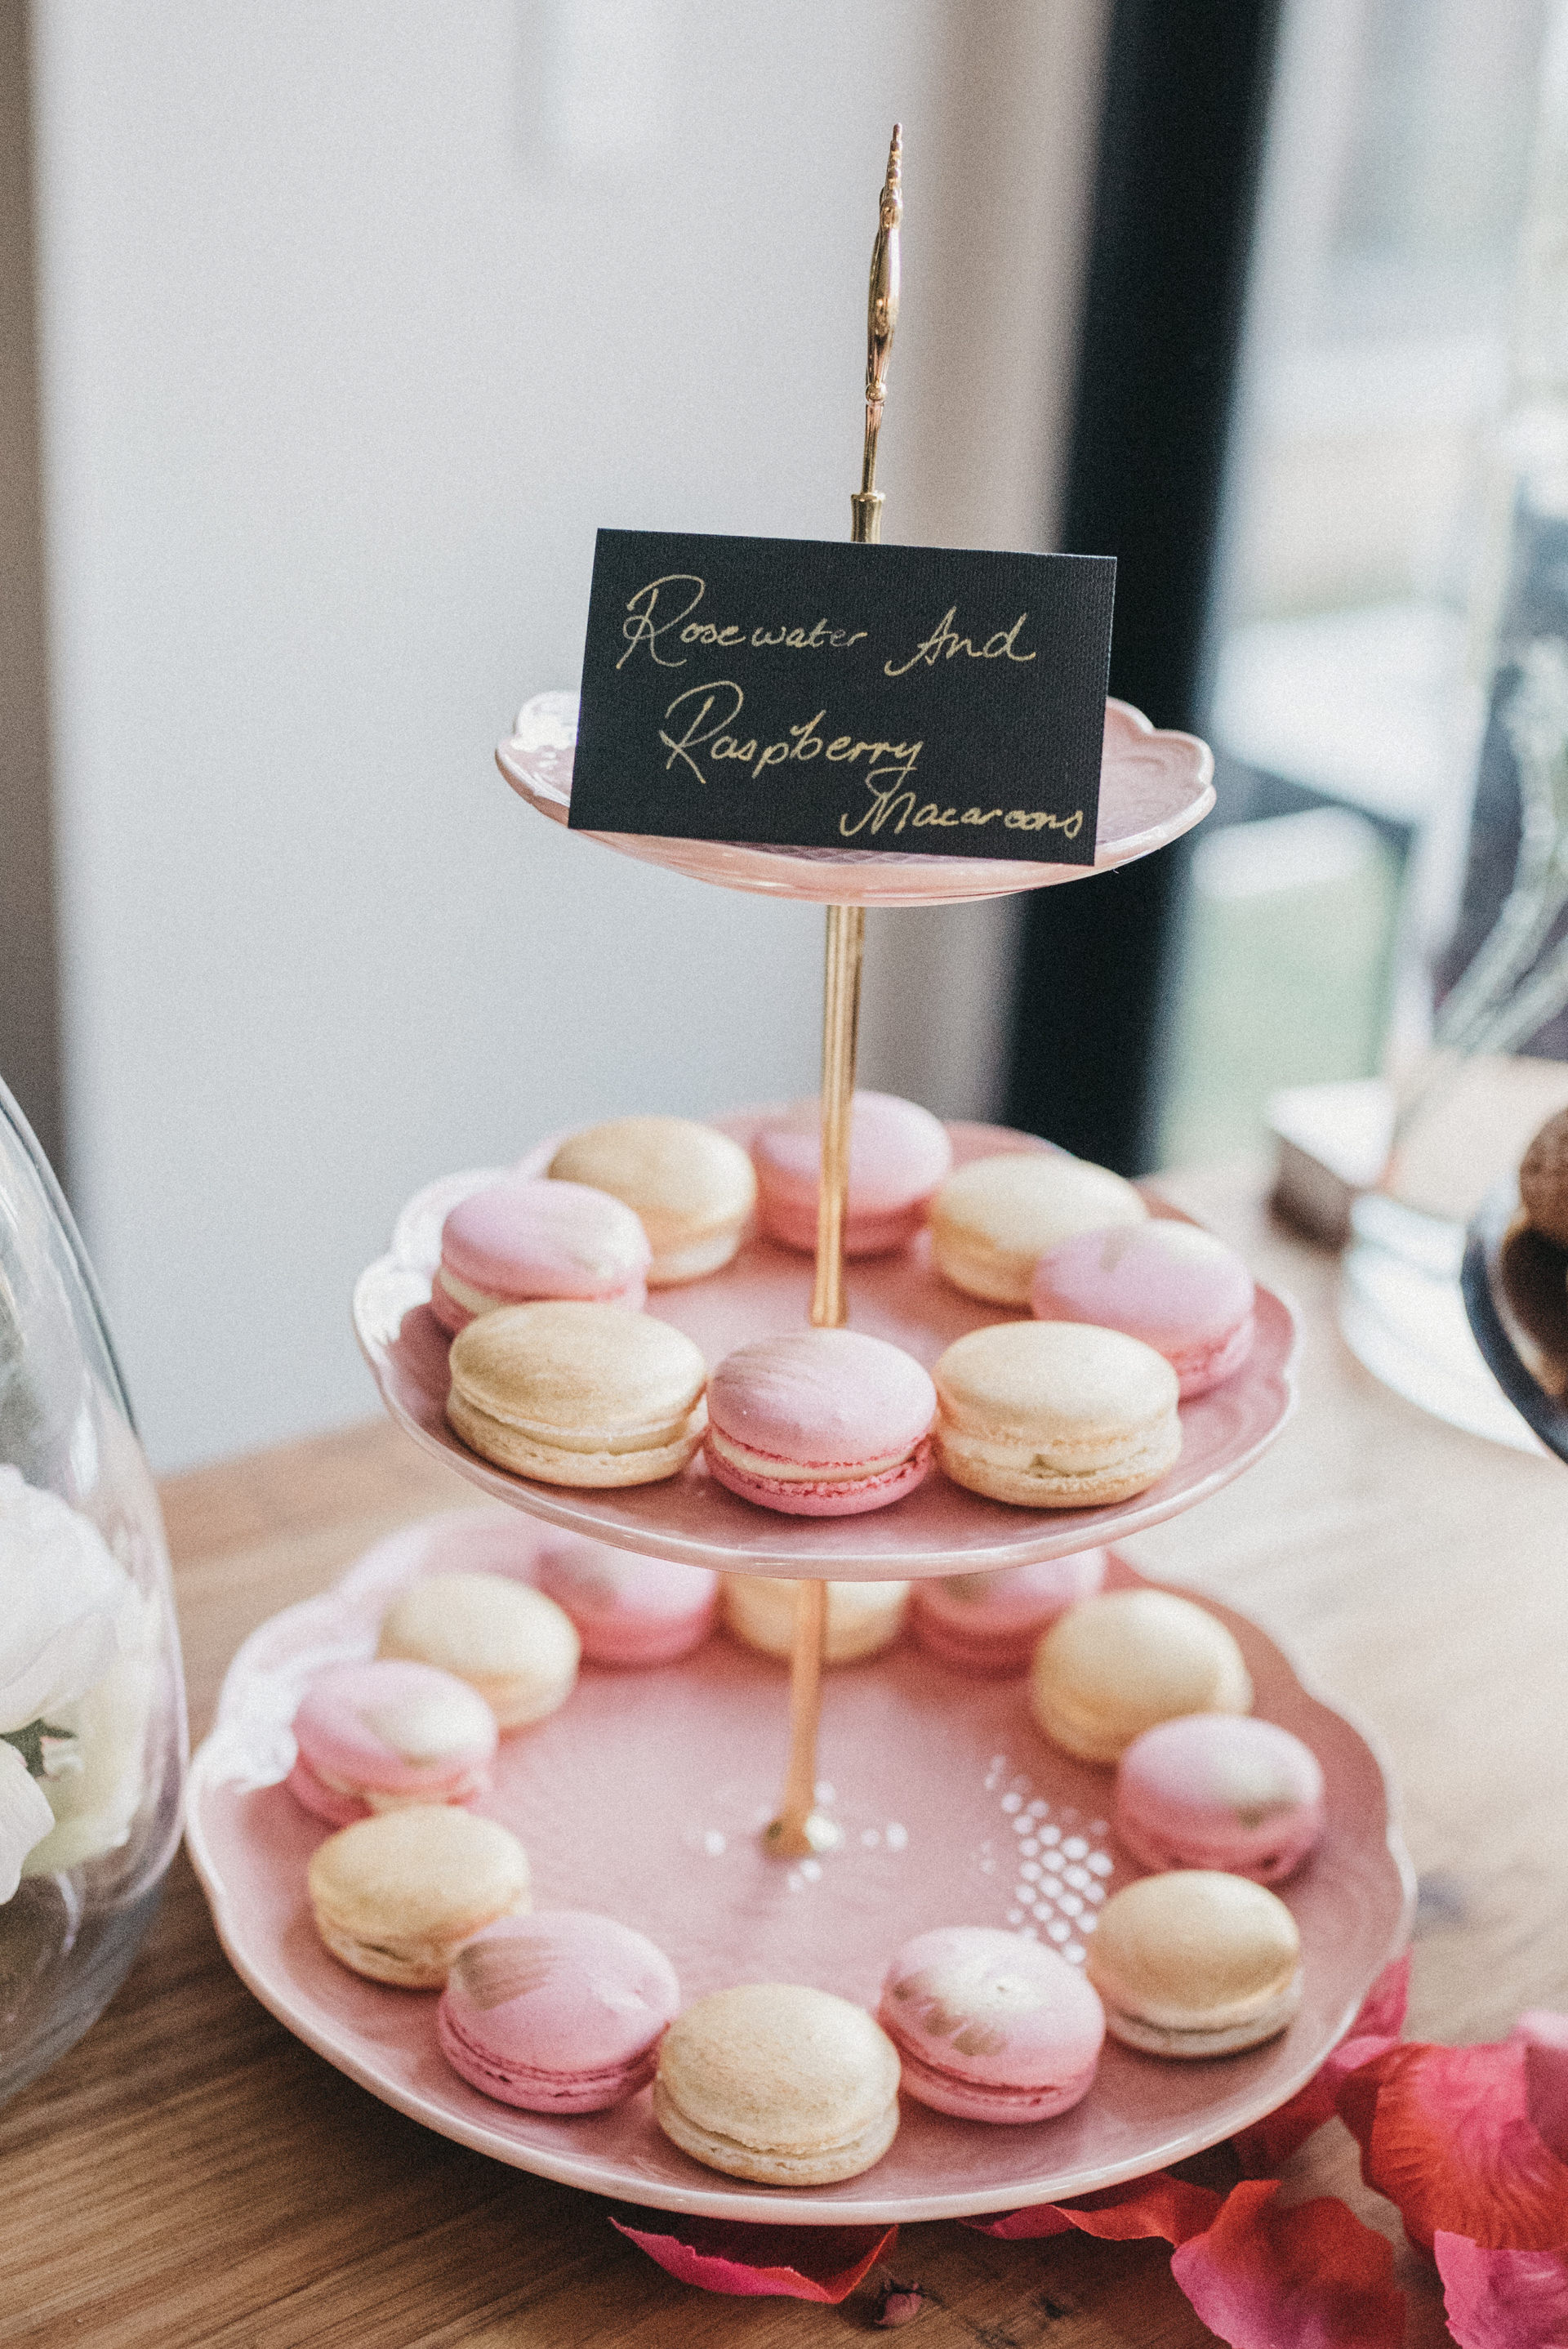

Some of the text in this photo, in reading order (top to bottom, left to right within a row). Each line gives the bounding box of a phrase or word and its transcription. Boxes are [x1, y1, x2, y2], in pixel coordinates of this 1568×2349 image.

[884, 606, 1036, 676] And
[659, 680, 924, 795] Raspberry
[840, 782, 1084, 840] Macaroons
